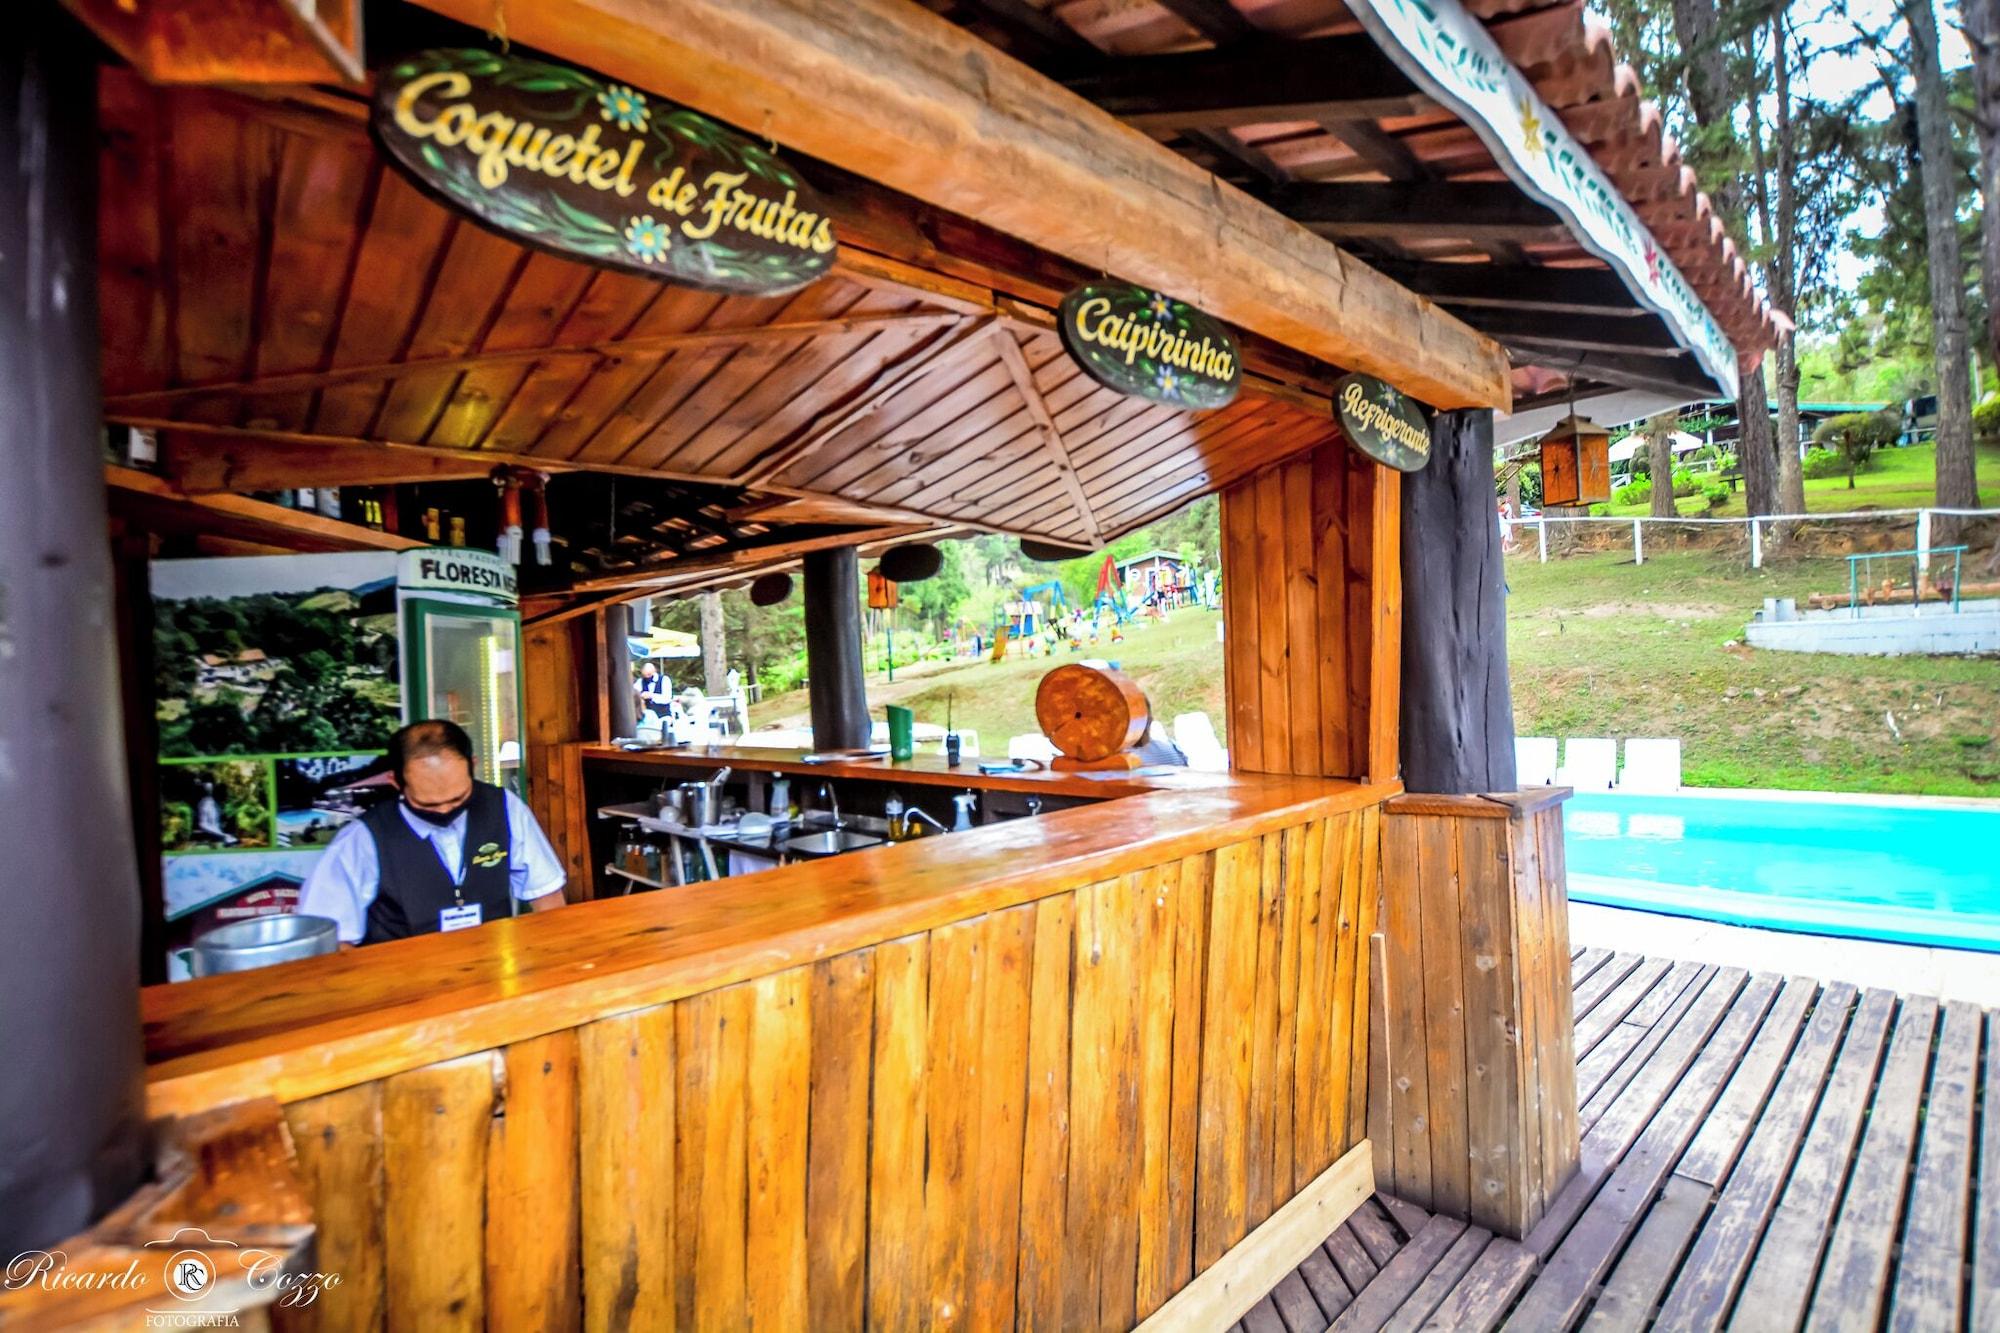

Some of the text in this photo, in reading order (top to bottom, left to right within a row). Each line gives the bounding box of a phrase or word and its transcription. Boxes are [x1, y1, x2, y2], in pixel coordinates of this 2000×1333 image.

[394, 71, 836, 254] Coquetel de Frutas
[1076, 297, 1235, 381] Caipirinha
[1343, 383, 1430, 456] Refrigerante
[420, 558, 501, 588] FLORESTA
